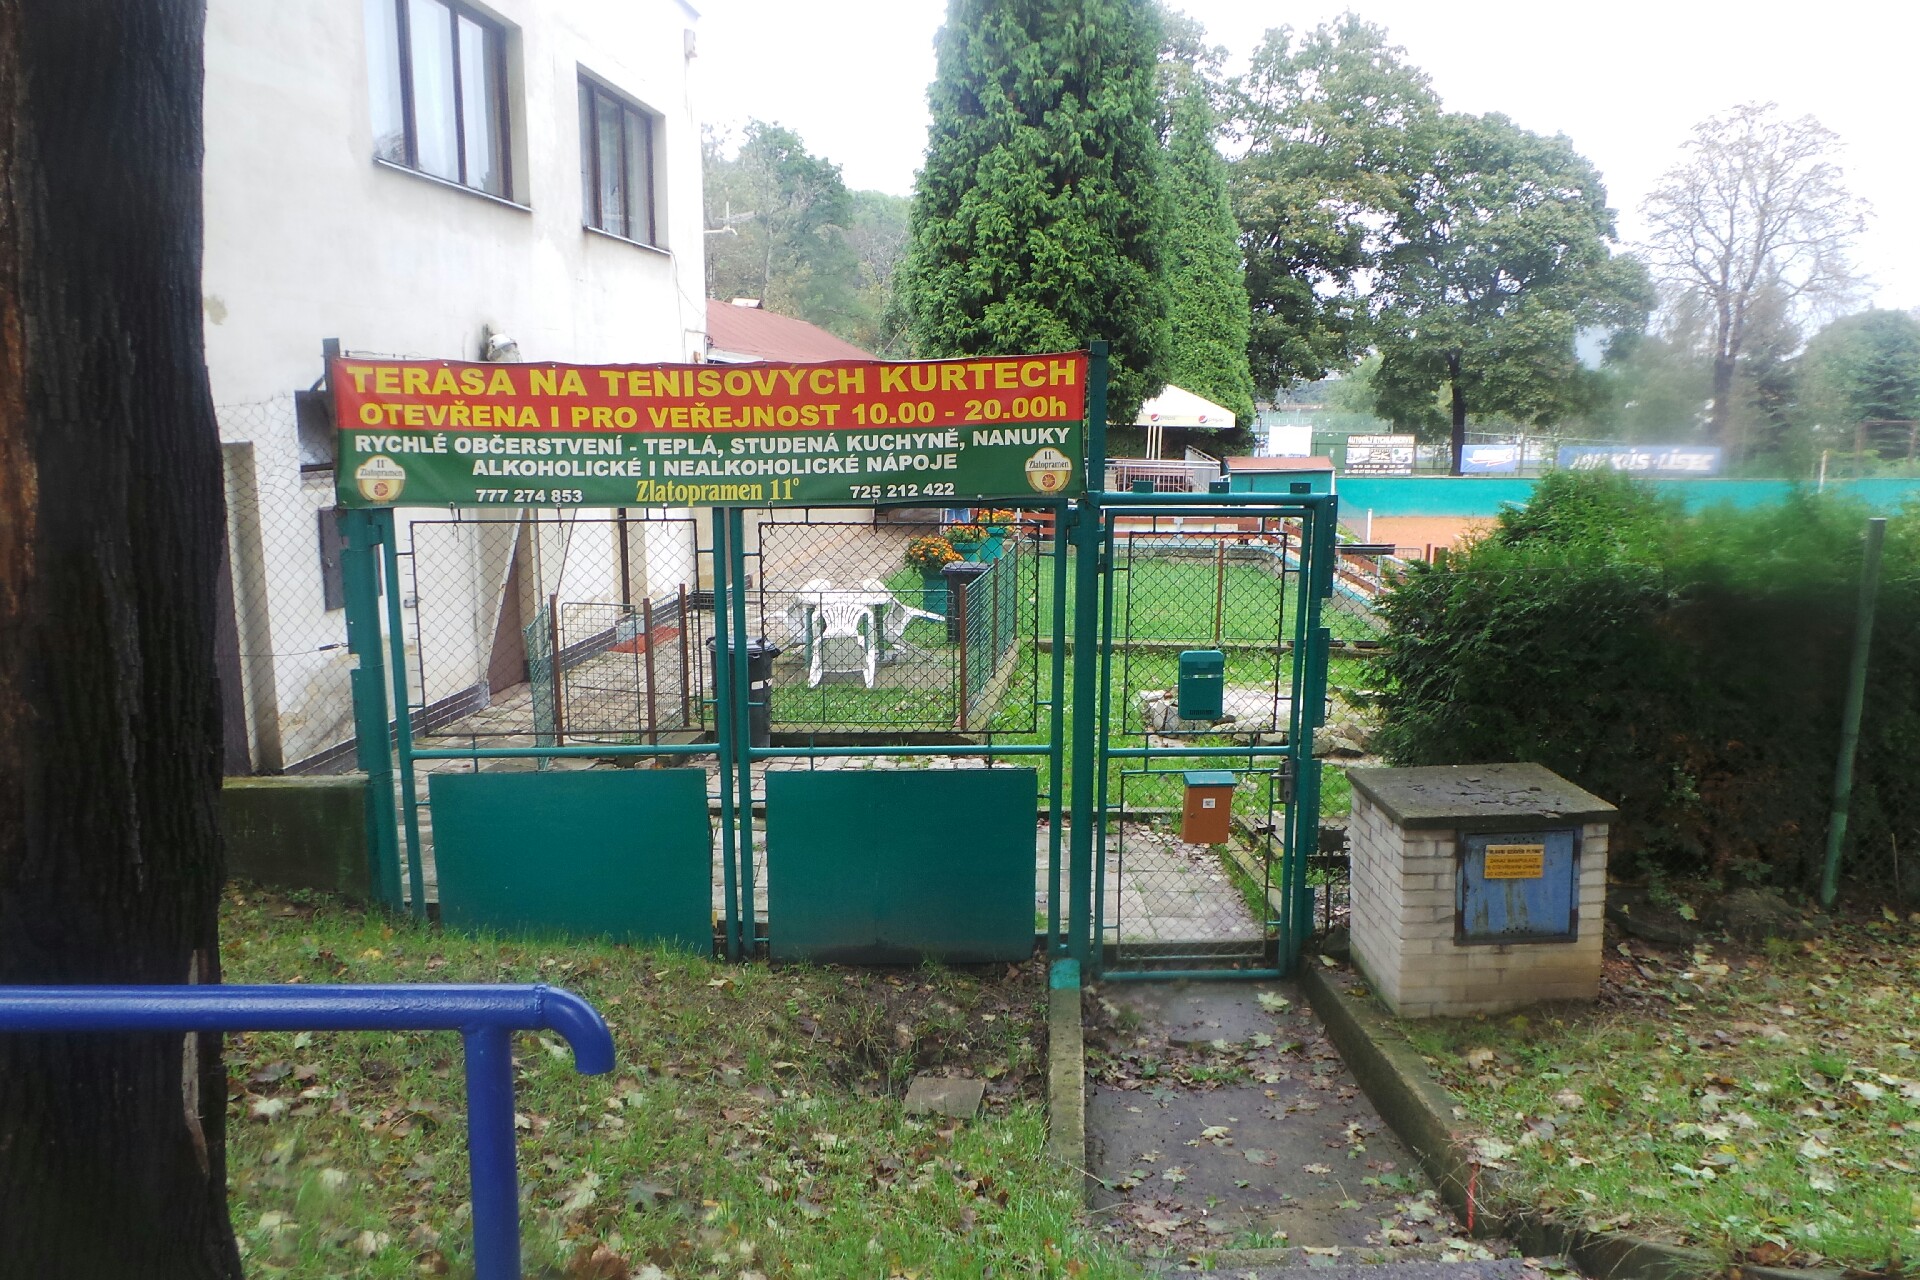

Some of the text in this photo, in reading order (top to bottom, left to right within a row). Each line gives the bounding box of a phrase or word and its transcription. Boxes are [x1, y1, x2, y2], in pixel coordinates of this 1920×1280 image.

[346, 359, 1076, 398] TERASA NA TENISOVÝCH KURTECH
[359, 400, 541, 428] OTEVŘENA
[550, 406, 560, 428] I
[571, 406, 638, 428] PRO
[647, 402, 841, 428] VEŘEJNOST
[851, 402, 936, 425] 10.00
[964, 396, 1067, 421] 20.00h
[355, 432, 448, 453] RYCHLÉ
[454, 434, 623, 455] OBČERSTVENÍ
[643, 434, 723, 458] TEPLÁ,
[731, 432, 840, 454] STUDENÁ
[846, 428, 965, 452] KUCHYNĚ,
[972, 427, 1071, 447] NANUKY
[360, 468, 403, 478] Zlatopramen
[472, 452, 958, 477] ALKOHOLICKÉ I NEALKOHOLICKÉ NÁPOJE
[1028, 460, 1069, 469] Zlatopramen
[475, 489, 583, 503] 777 274 853
[635, 480, 763, 507] Zlatopramen
[850, 482, 955, 499] 725 212 422
